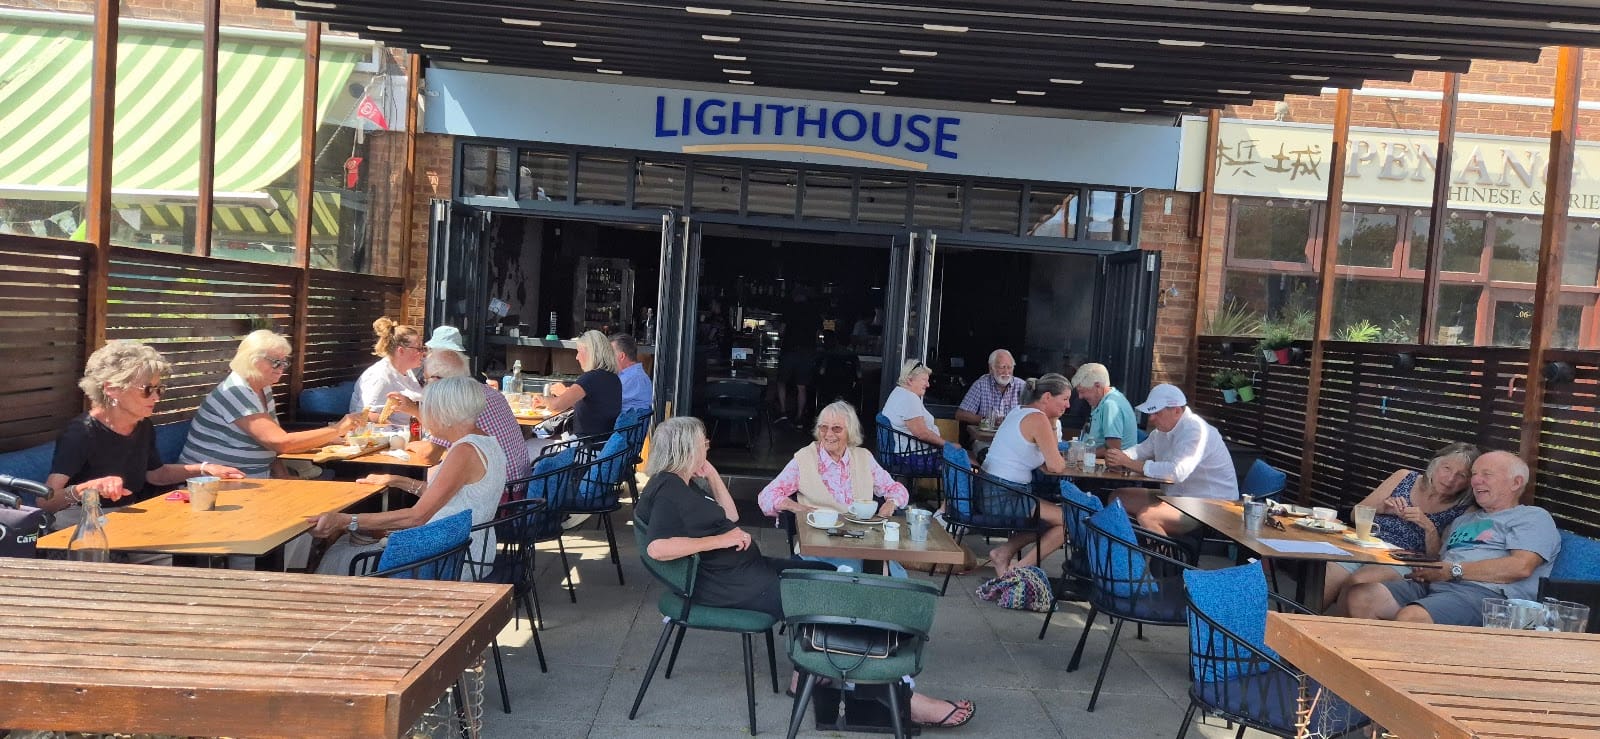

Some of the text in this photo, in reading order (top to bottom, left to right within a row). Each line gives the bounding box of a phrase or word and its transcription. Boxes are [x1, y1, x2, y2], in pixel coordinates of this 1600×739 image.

[655, 96, 960, 159] LIGHTHOUSE
[1448, 185, 1522, 206] HINESE
[1529, 190, 1544, 206] &
